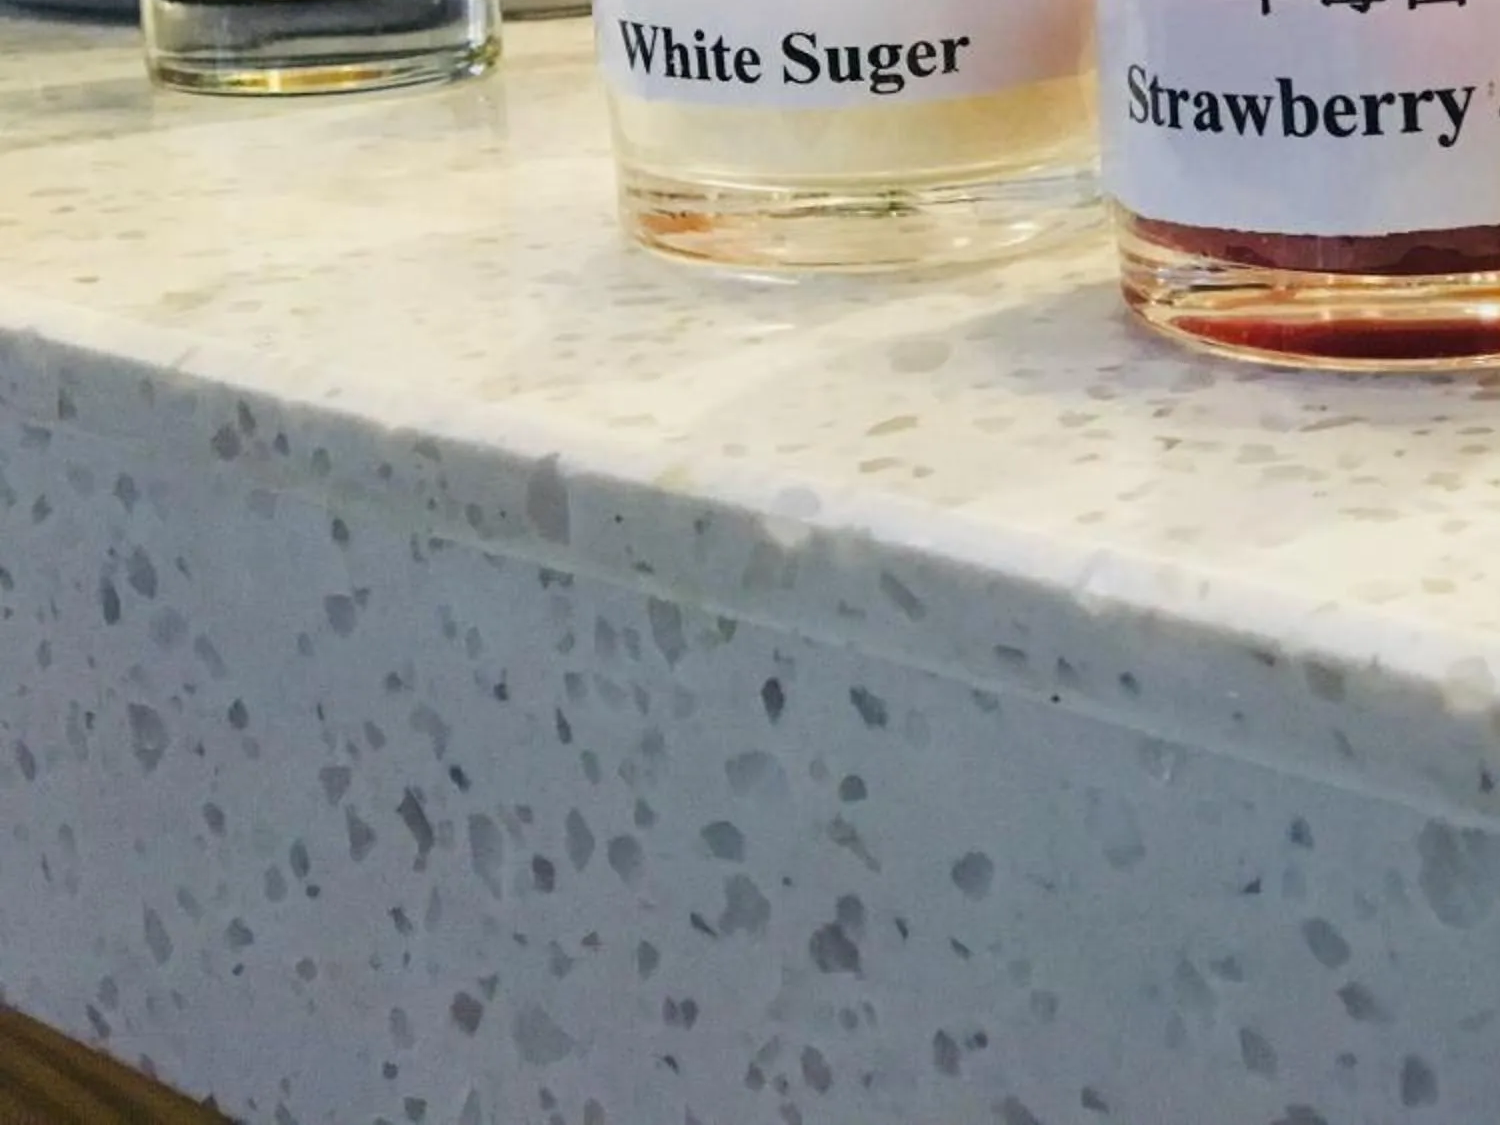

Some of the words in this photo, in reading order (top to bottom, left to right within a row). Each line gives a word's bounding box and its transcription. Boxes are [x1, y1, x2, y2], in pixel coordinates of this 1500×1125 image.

[618, 19, 762, 83] White
[781, 31, 970, 94] Suger
[1127, 64, 1476, 148] Strawberry
